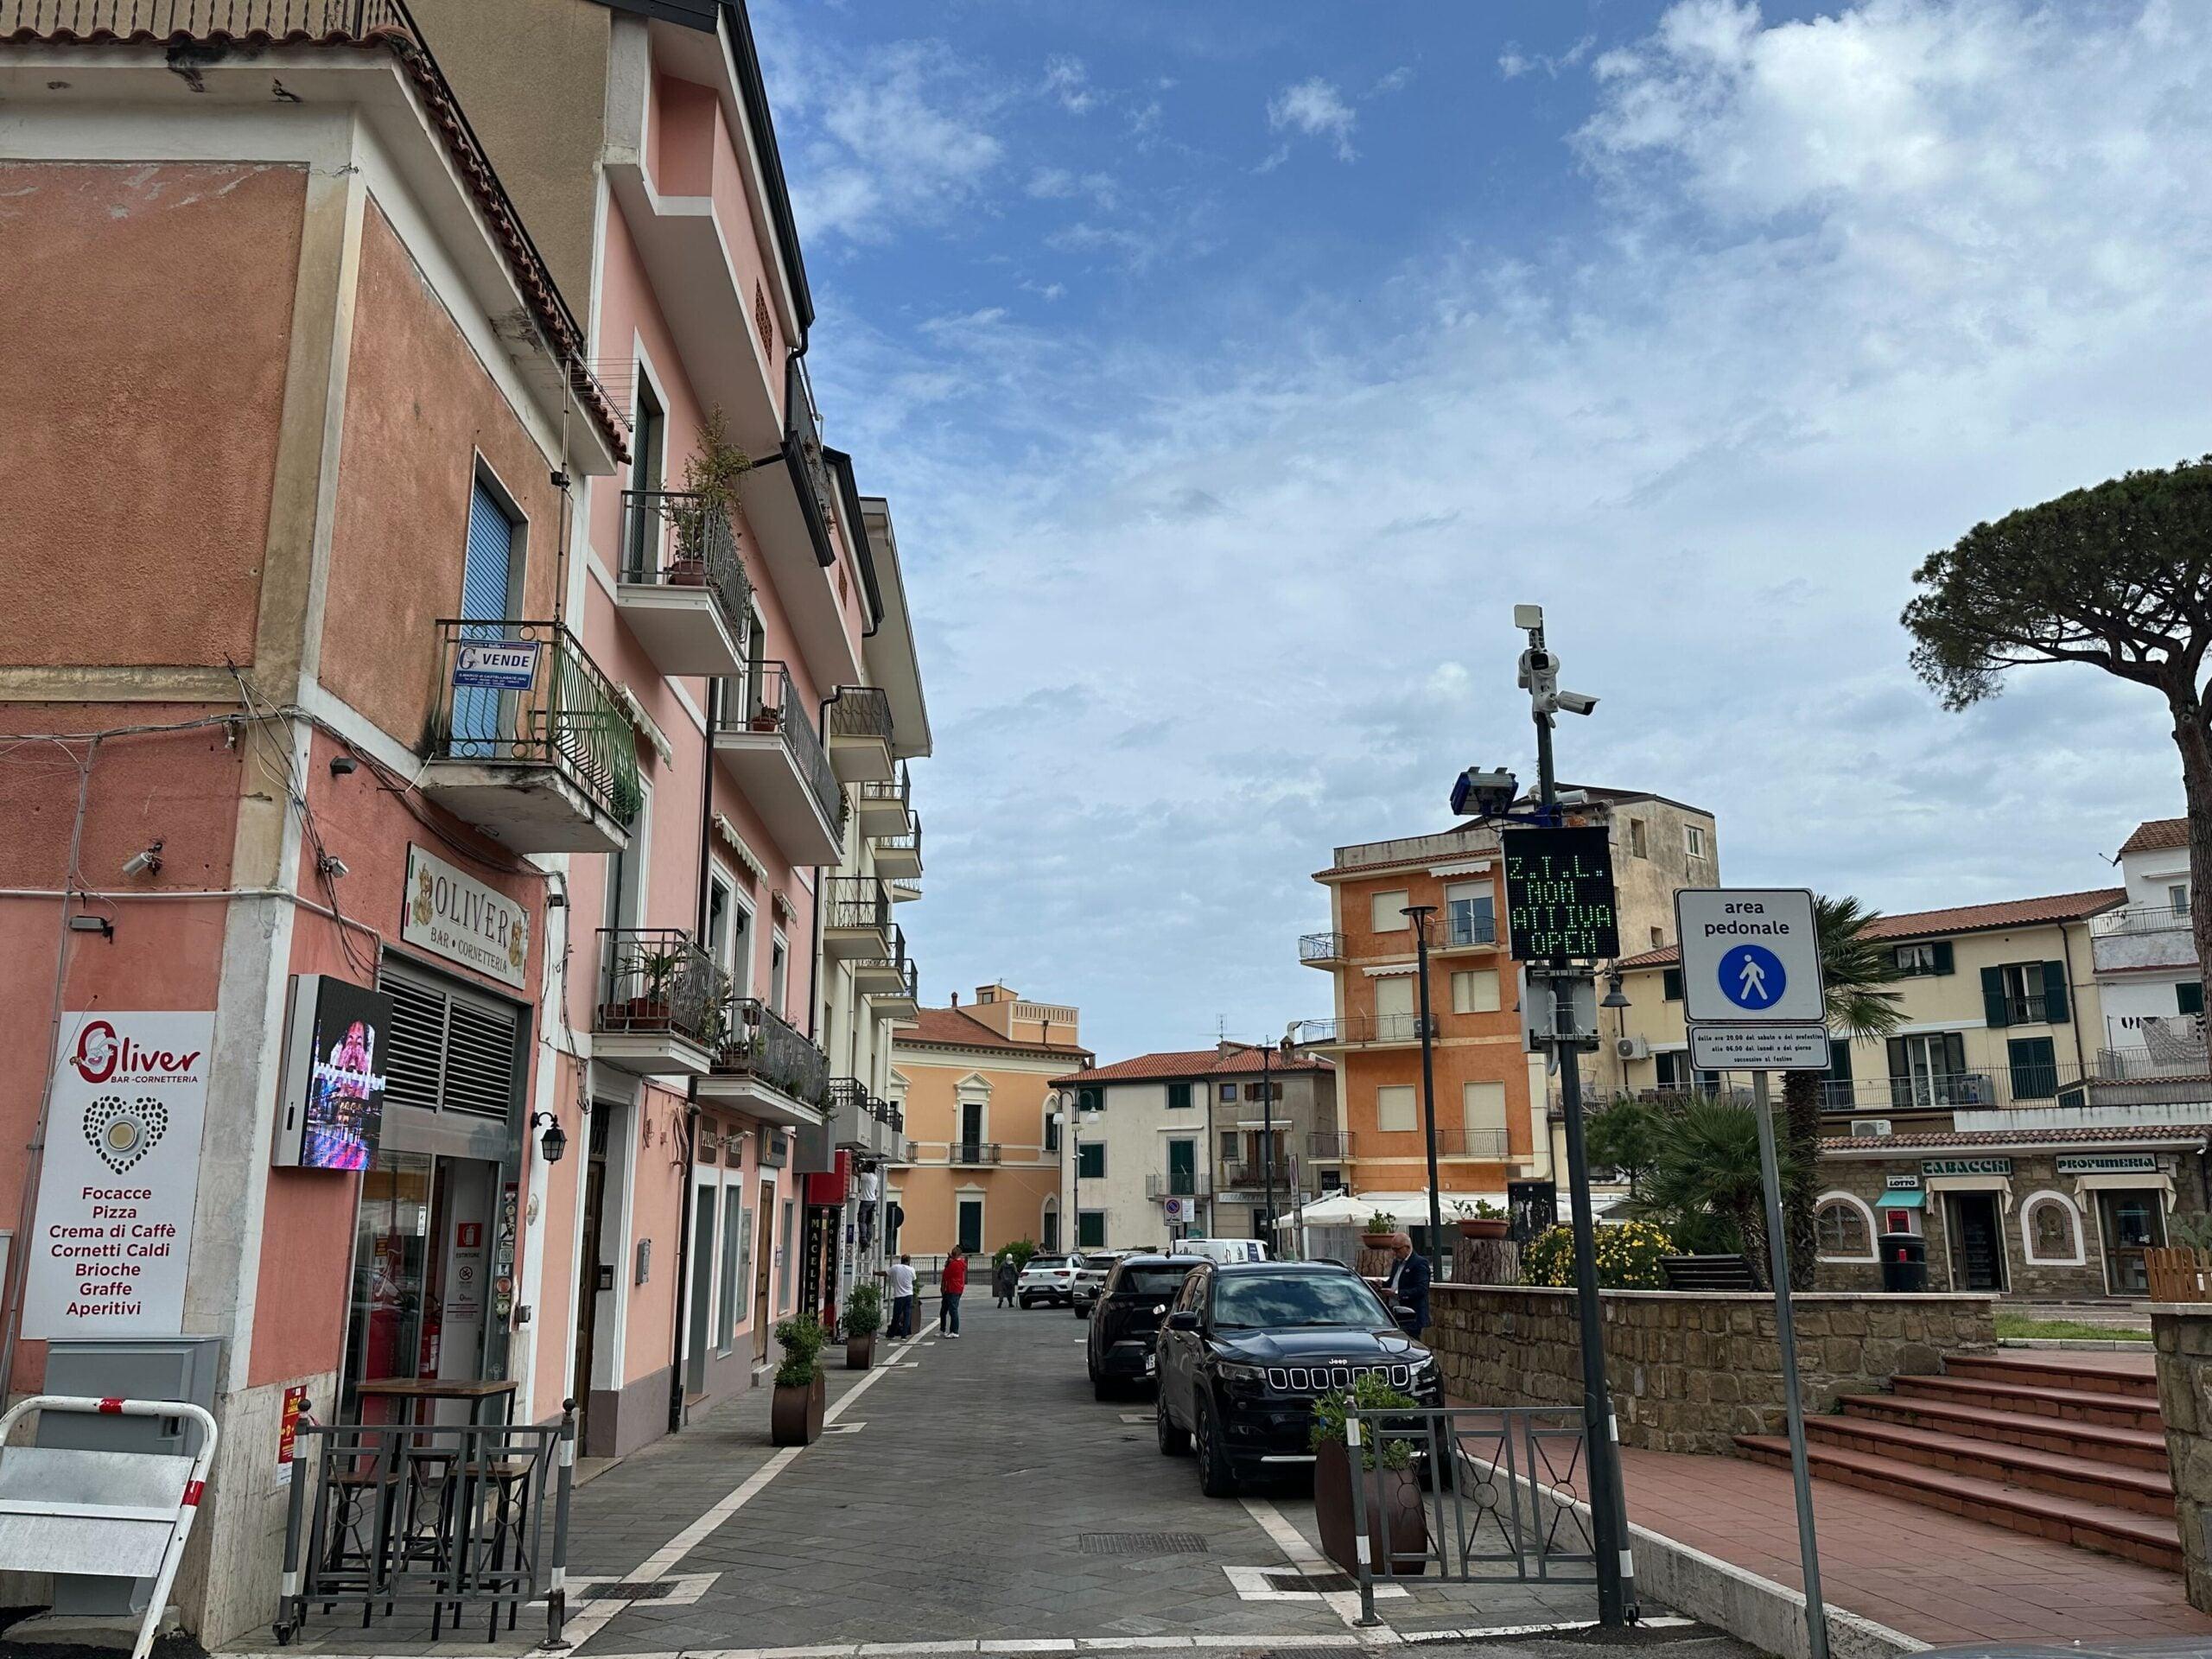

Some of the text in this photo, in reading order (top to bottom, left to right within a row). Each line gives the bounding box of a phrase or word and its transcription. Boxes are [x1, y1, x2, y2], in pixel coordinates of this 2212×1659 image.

[482, 653, 531, 667] VENDE
[1508, 855, 1603, 880] Z.T.L.
[1527, 880, 1575, 904] NON
[435, 875, 510, 950] OLIVER
[1725, 902, 1764, 914] area
[1512, 905, 1611, 930] ATTIVA
[1704, 920, 1789, 938] pedonale
[430, 926, 507, 975] BAR CORNETTERIA
[1531, 931, 1597, 955] OPEN
[77, 1020, 201, 1084] Oliver
[111, 1075, 130, 1084] BAR
[1923, 1160, 2010, 1173] TABACCHI
[2057, 1157, 2155, 1169] PROFUMERIA
[82, 1186, 152, 1200] Focacce
[92, 1205, 137, 1219] Pizza
[49, 1223, 176, 1238] Crema di Caffè
[50, 1243, 170, 1257] Cornetti Caldi
[75, 1262, 141, 1277] Brioche
[808, 1218, 820, 1327] MACELLER
[79, 1281, 132, 1296] Graffe
[66, 1300, 142, 1319] Aperitivi
